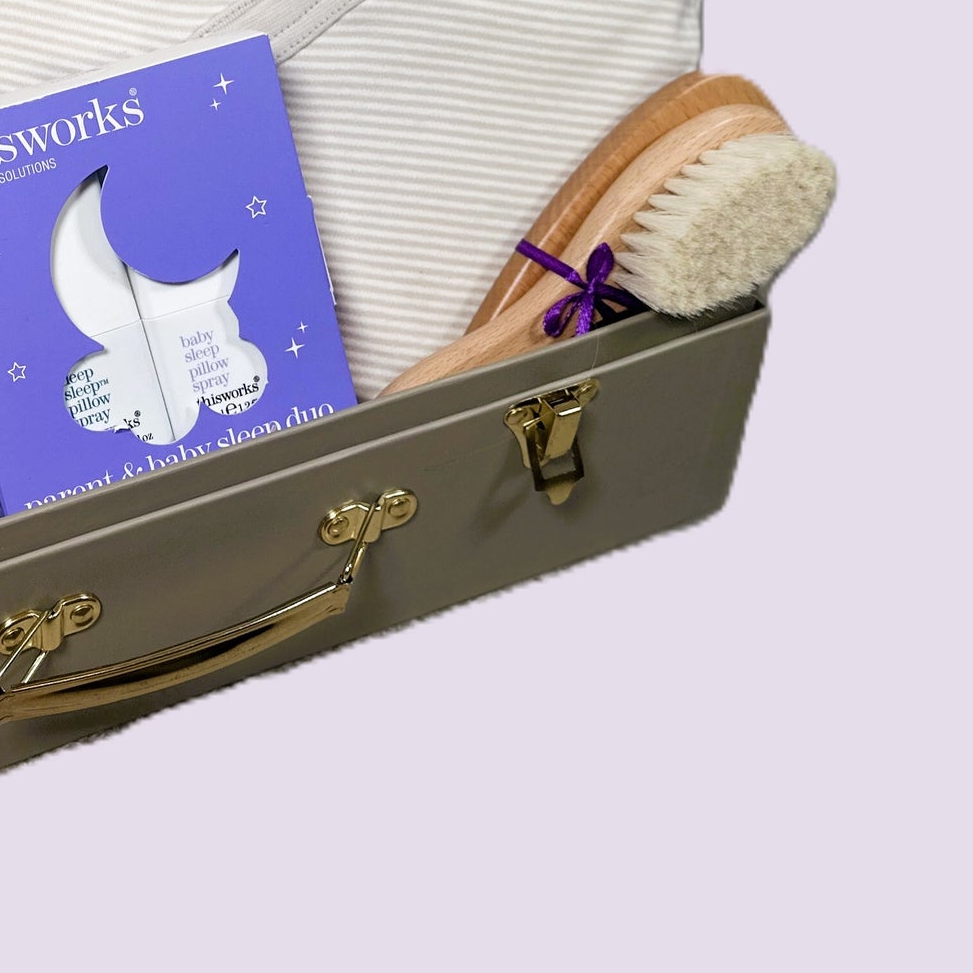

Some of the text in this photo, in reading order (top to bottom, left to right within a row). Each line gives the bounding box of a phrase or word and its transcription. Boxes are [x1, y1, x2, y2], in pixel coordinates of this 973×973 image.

[0, 158, 57, 185] SOLUTIONS
[179, 330, 214, 348] baby
[184, 344, 220, 363] sleep
[188, 358, 229, 382] pillow
[192, 372, 230, 394] spray
[68, 393, 111, 419] pillow
[76, 408, 111, 427] pray
[286, 402, 334, 428] duo
